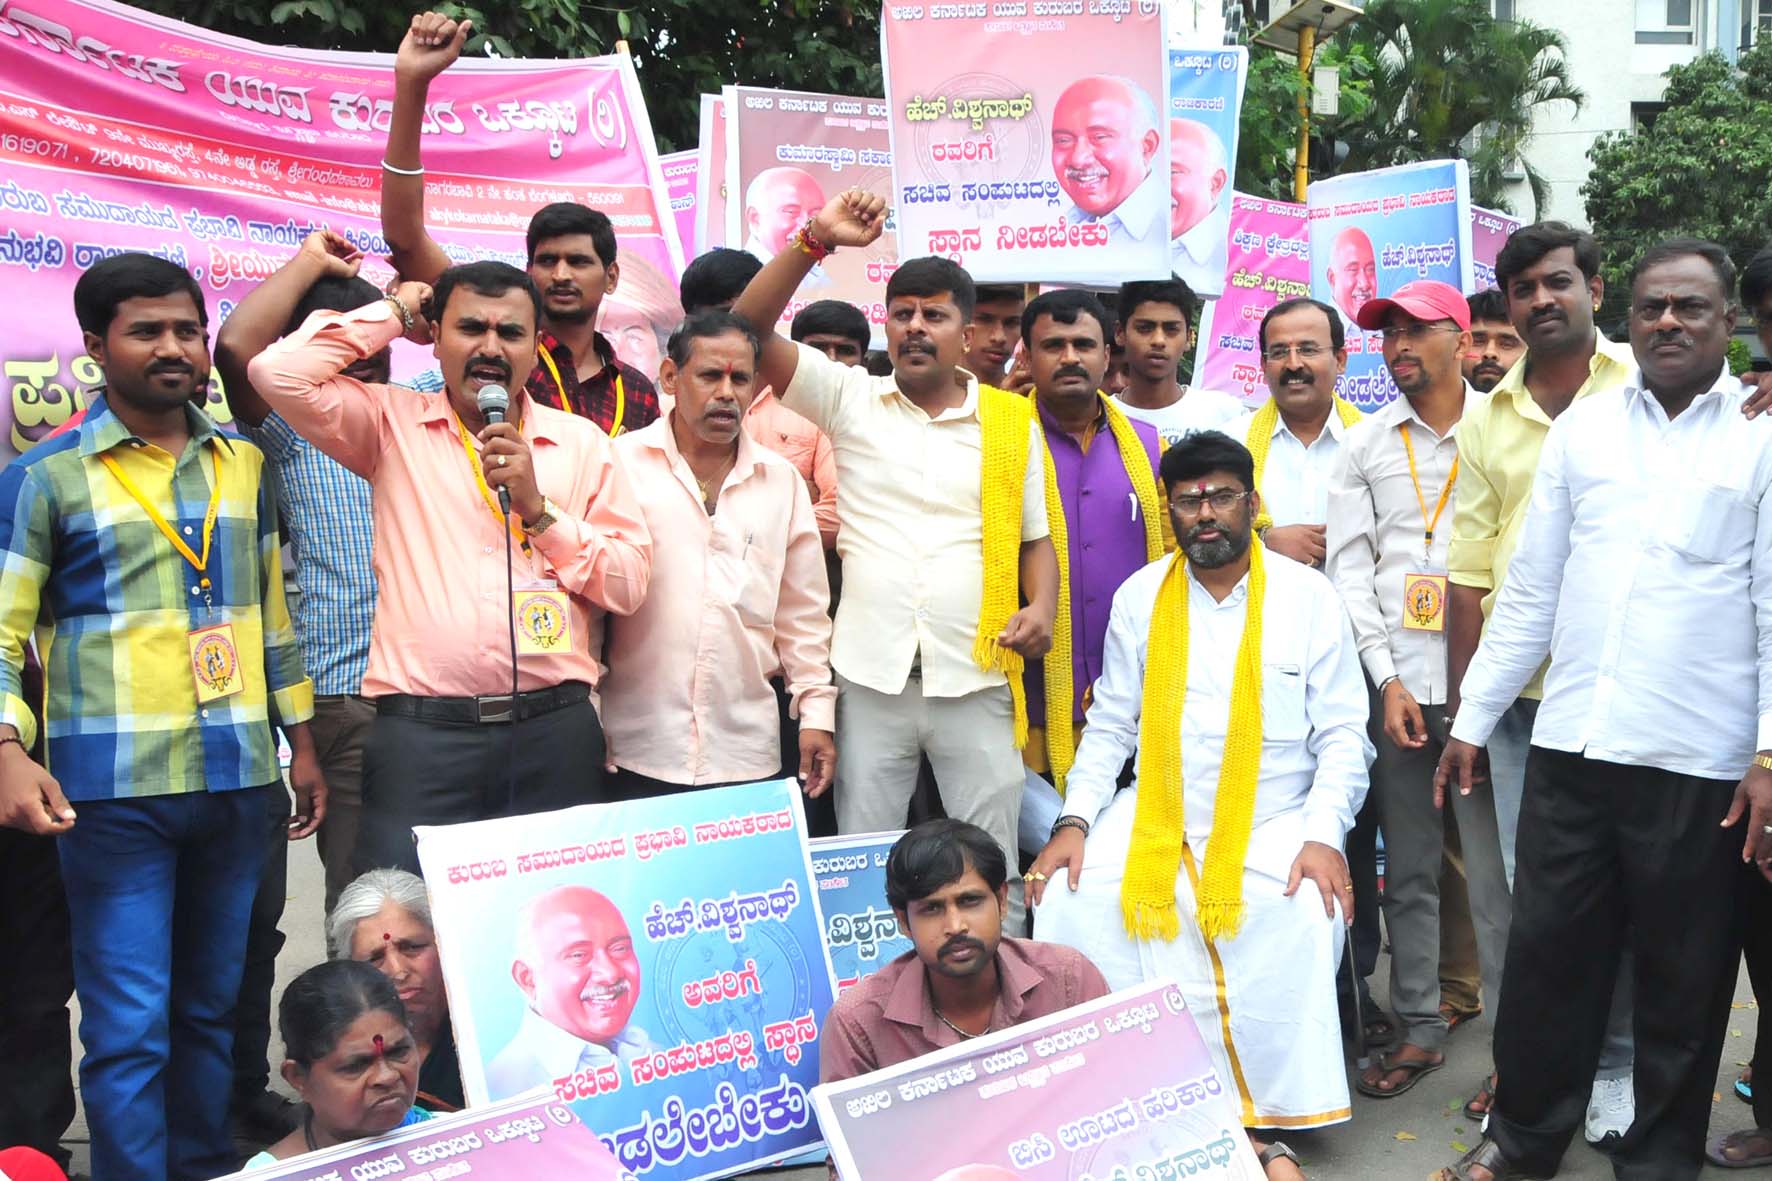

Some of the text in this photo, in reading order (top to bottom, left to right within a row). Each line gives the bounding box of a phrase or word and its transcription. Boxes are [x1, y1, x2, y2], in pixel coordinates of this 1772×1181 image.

[204, 70, 316, 125] ಯುವ
[471, 98, 578, 160] ಒಕ್ಕೂಟ
[778, 97, 828, 114] ಕರ್ನಾಟಕ
[833, 101, 863, 116] ಯುವ
[931, 134, 994, 162] ರವರಿಗೆ
[55, 190, 183, 234] ಸಮುದಾಯದ
[903, 179, 1060, 207] ಸಚಿವ ಸಂಪುಟದಲ್ಲಿ
[996, 216, 1110, 251] ನೀಡಬೇಕು
[446, 809, 794, 886] ಕುರುಬ ಸಮುದಾಯದ ಪ್ರಭಾವಿ ನಾಯಕರಾದ
[813, 851, 869, 875] ಕುರುಬರ
[644, 880, 799, 941] ಹೆಚ್.ವಿಶ್ವನಾಥ್
[682, 959, 762, 1007] ಅವರಿಗೆ
[552, 1014, 818, 1103] ಸಚಿವ ಸಂಪುಟದಲ್ಲಿ ಸ್ಥಾನ
[845, 1087, 893, 1120] ಅಖಿಲ
[898, 1066, 978, 1104] ಕರ್ನಾಟಕ
[982, 1045, 1030, 1076] ಯುವ
[1035, 1022, 1101, 1060] ಕುರುಬರ
[1104, 1004, 1161, 1037] ಒಕ್ಕೂಟ
[407, 1130, 484, 1166] ಕುರುಬರ
[484, 1114, 546, 1144] ಒಕ್ಕೂಟ
